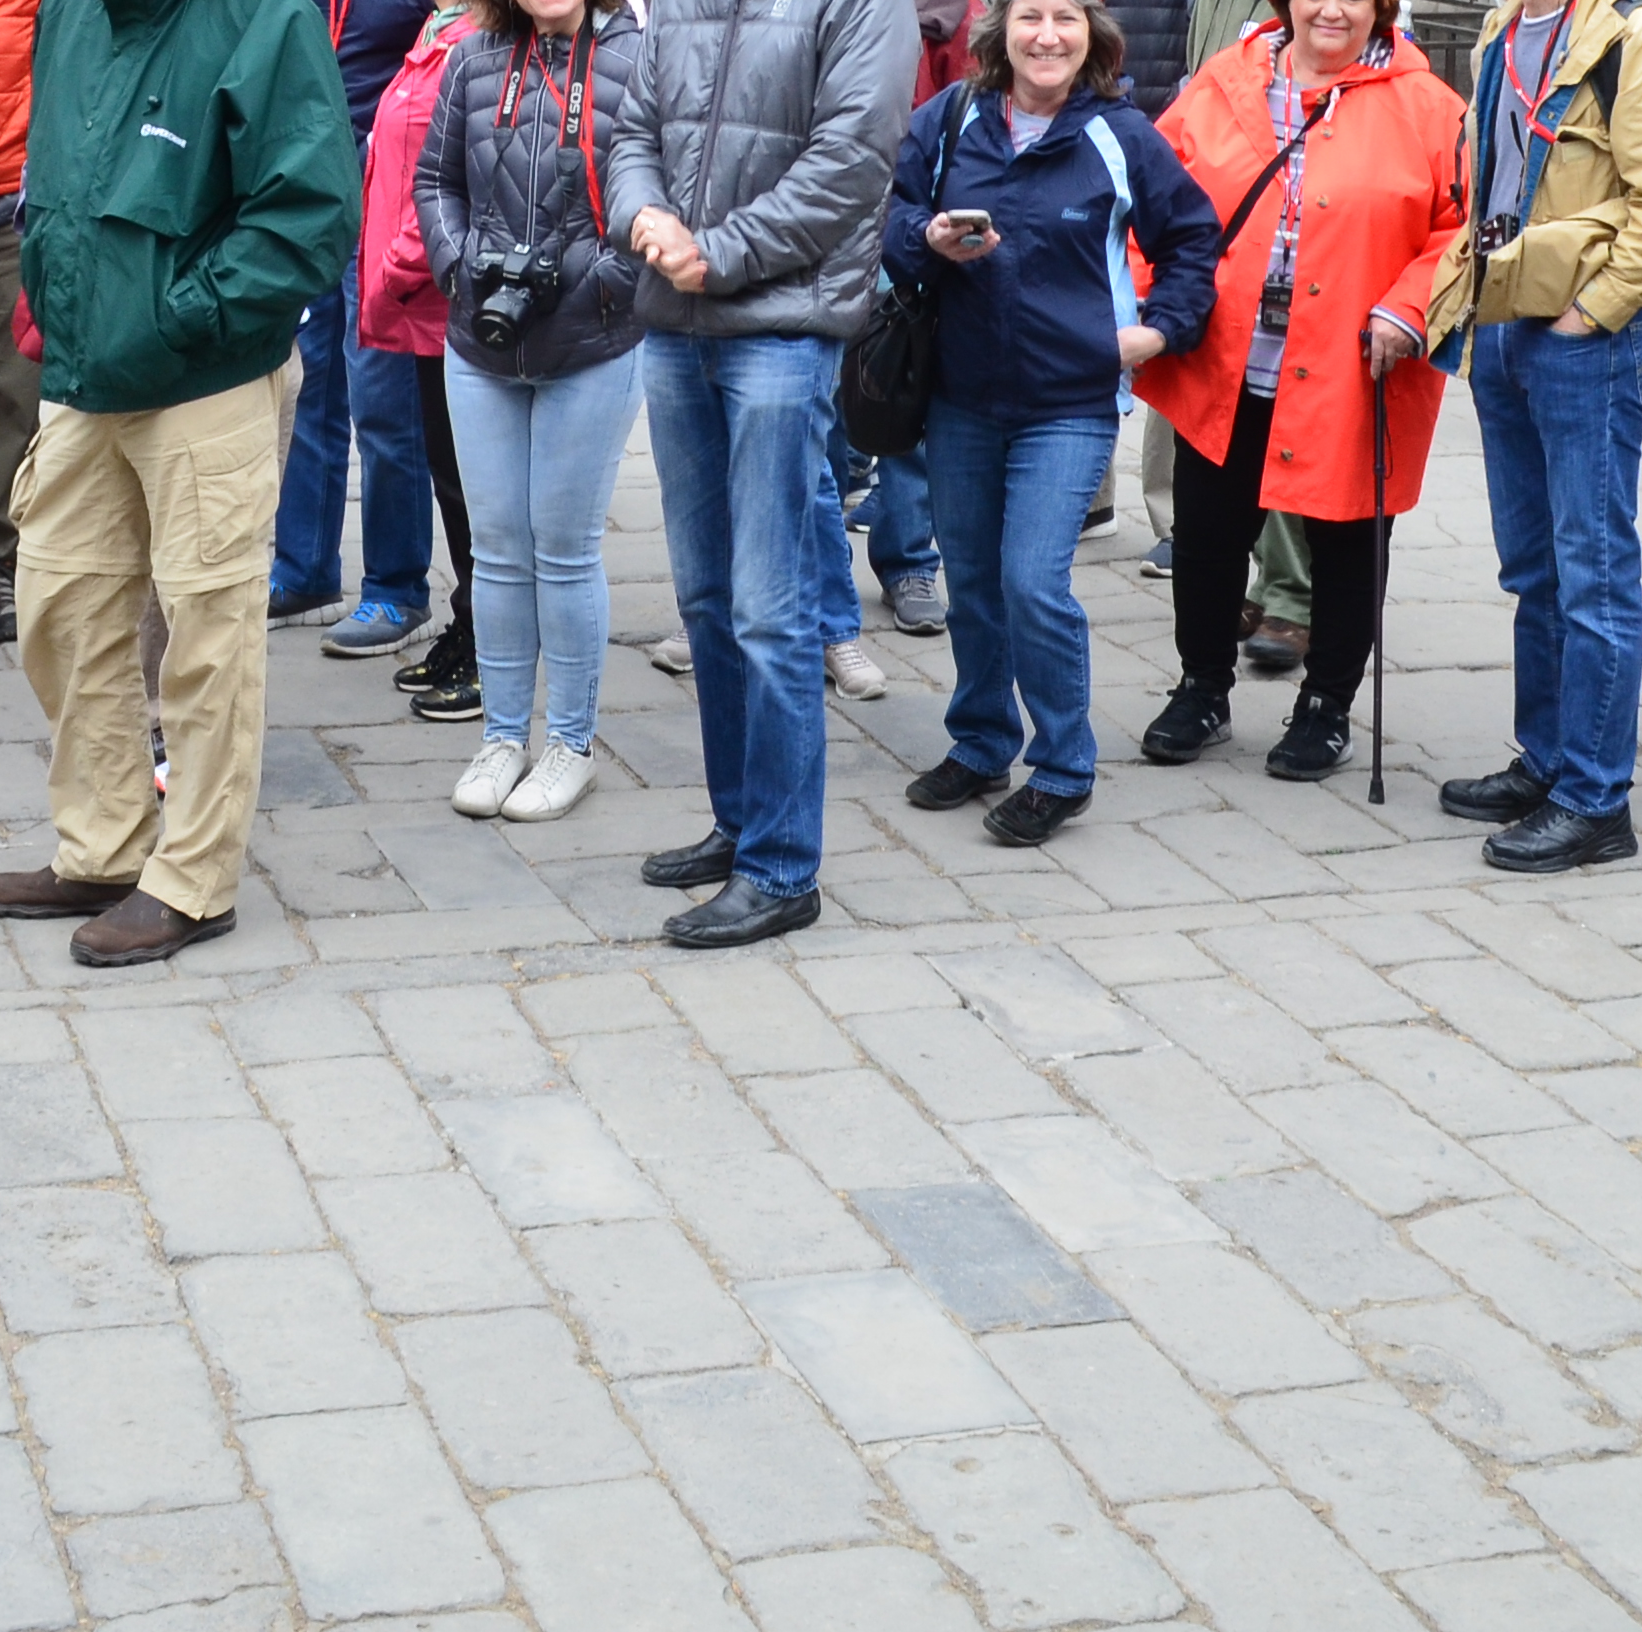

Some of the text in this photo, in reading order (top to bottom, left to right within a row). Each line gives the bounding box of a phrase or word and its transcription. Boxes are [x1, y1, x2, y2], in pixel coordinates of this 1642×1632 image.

[502, 70, 521, 115] Canon
[566, 81, 583, 134] EOS 7D
